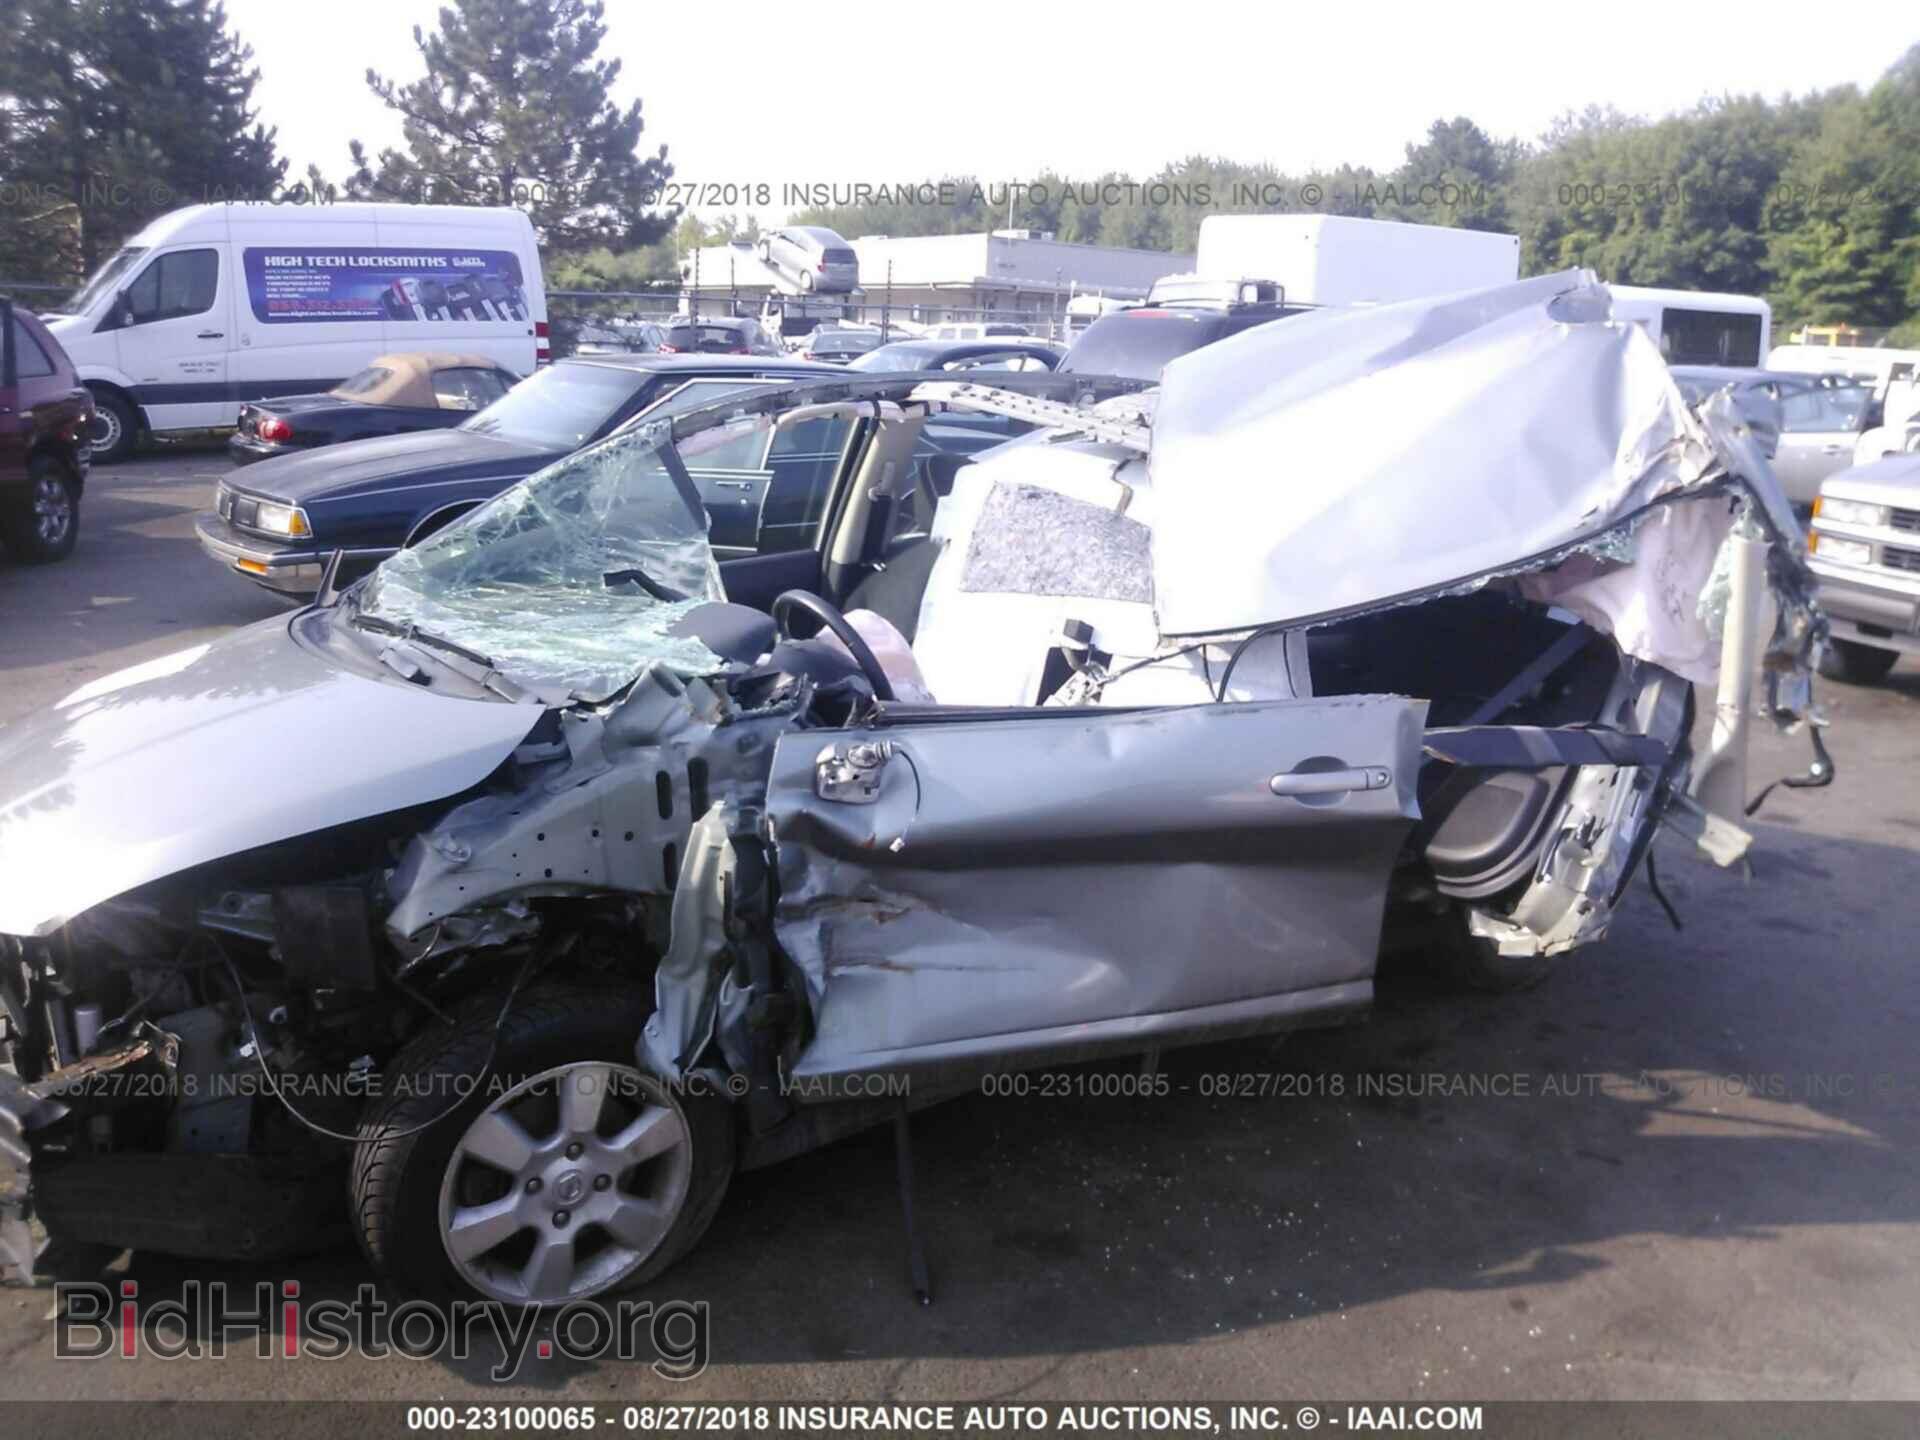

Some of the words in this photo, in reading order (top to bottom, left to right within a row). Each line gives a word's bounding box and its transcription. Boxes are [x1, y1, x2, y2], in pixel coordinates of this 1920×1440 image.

[264, 256, 303, 267] HIGH
[305, 256, 346, 267] TECH
[348, 256, 448, 267] LOCKSMITHS
